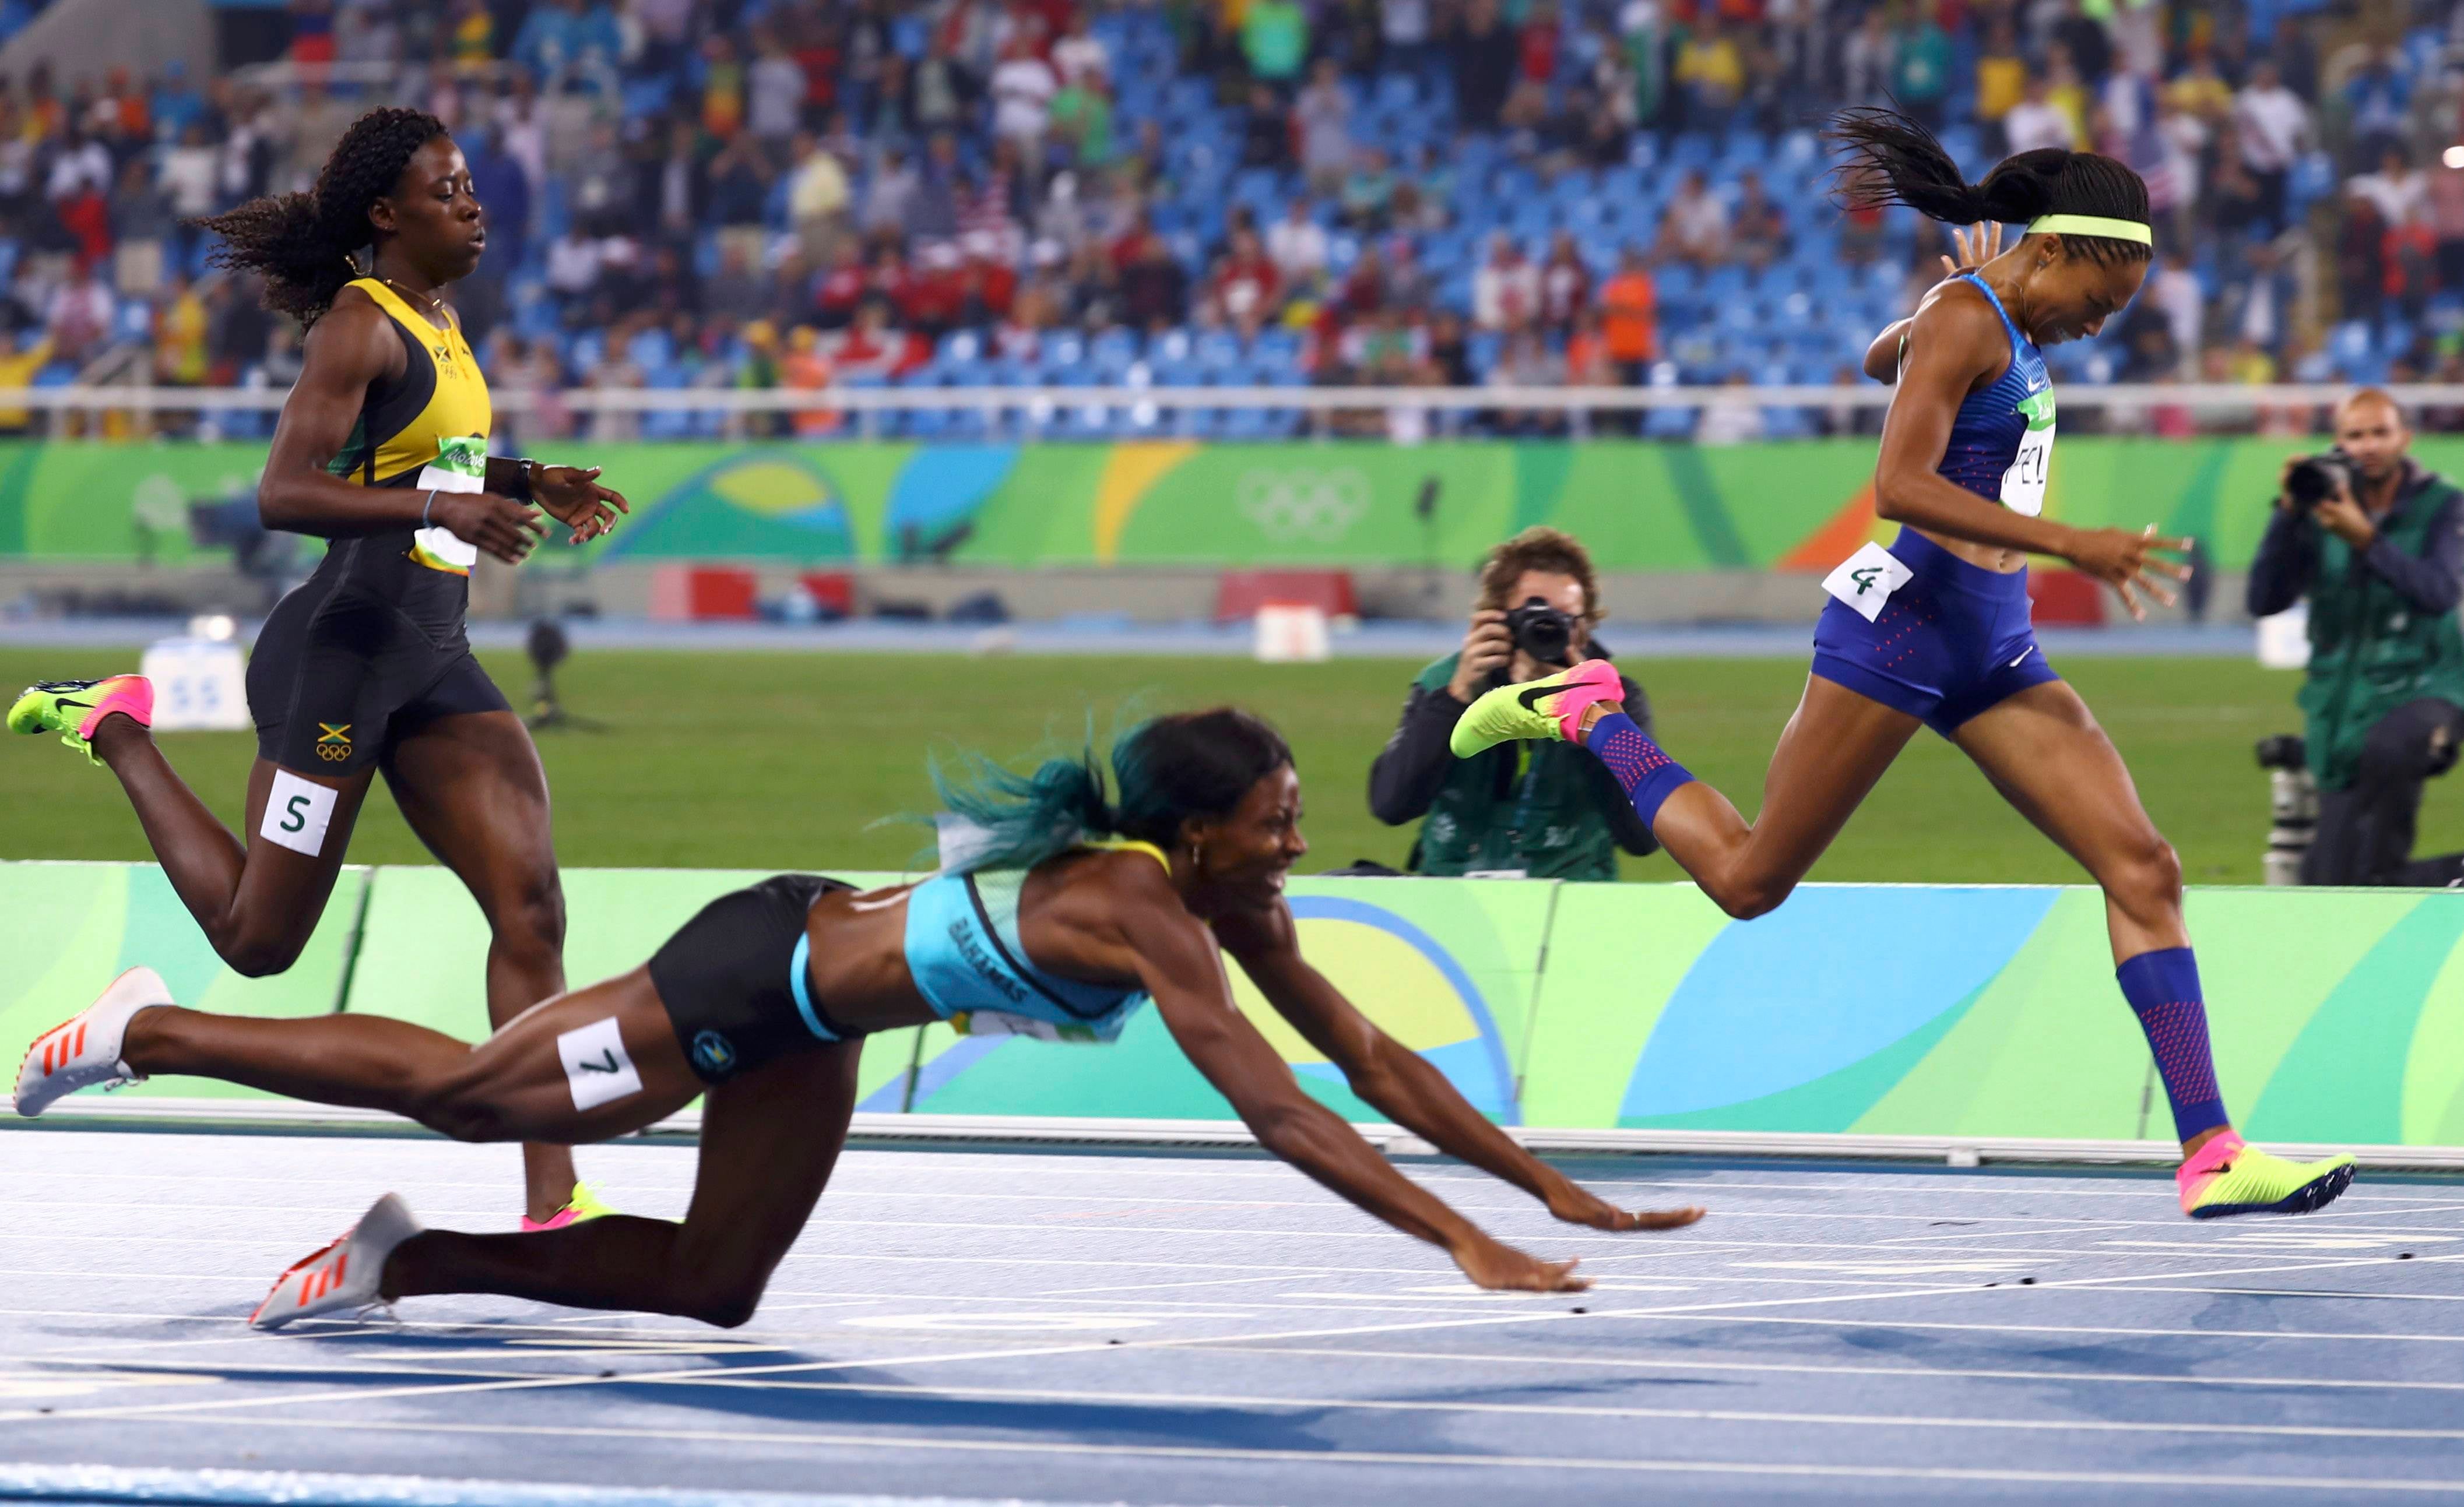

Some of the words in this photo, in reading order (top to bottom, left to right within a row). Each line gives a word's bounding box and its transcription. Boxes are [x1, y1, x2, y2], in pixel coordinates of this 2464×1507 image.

[1851, 567, 1883, 595] 4
[280, 795, 311, 832] 5
[948, 917, 1029, 1003] BAHAMAS
[579, 1047, 619, 1073] 7
